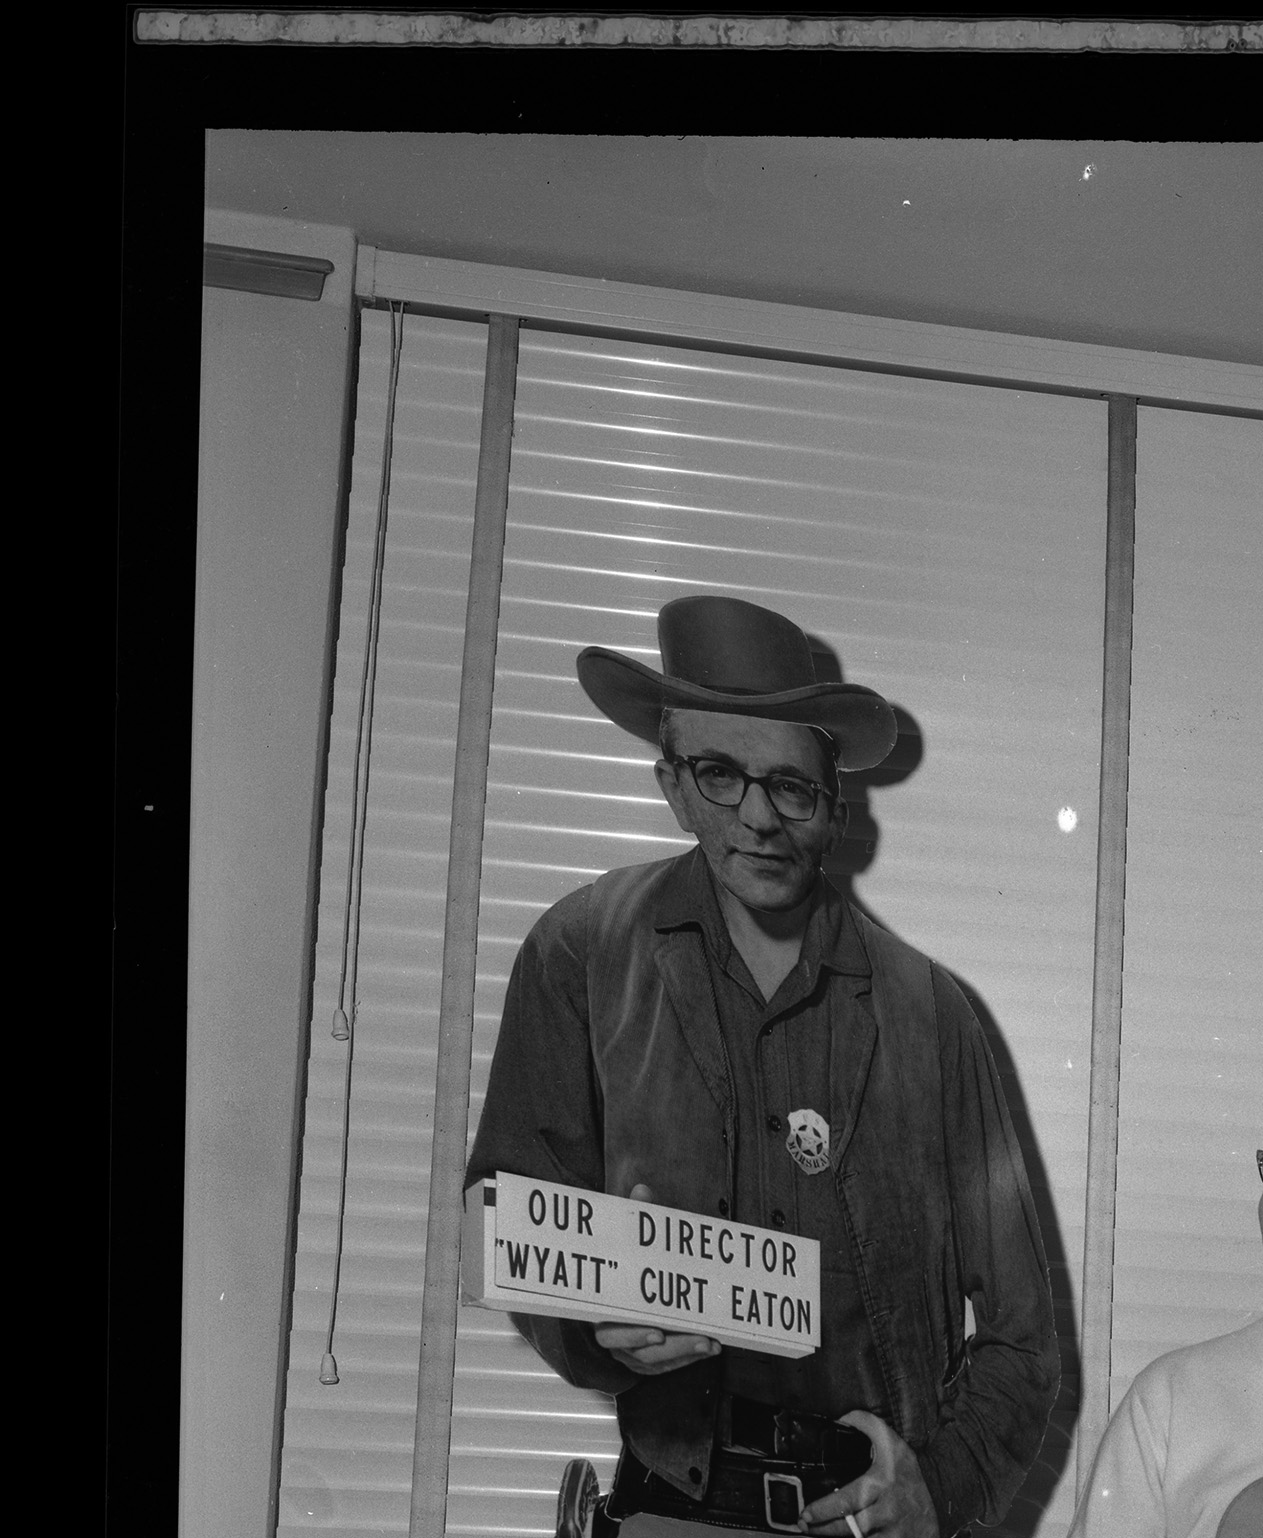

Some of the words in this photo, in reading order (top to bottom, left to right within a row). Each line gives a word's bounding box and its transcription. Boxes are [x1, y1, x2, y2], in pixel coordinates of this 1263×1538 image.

[528, 1188, 594, 1237] OUR
[638, 1210, 797, 1278] DIRECTOR
[639, 1266, 709, 1314] CURT
[730, 1284, 811, 1335] EATON
